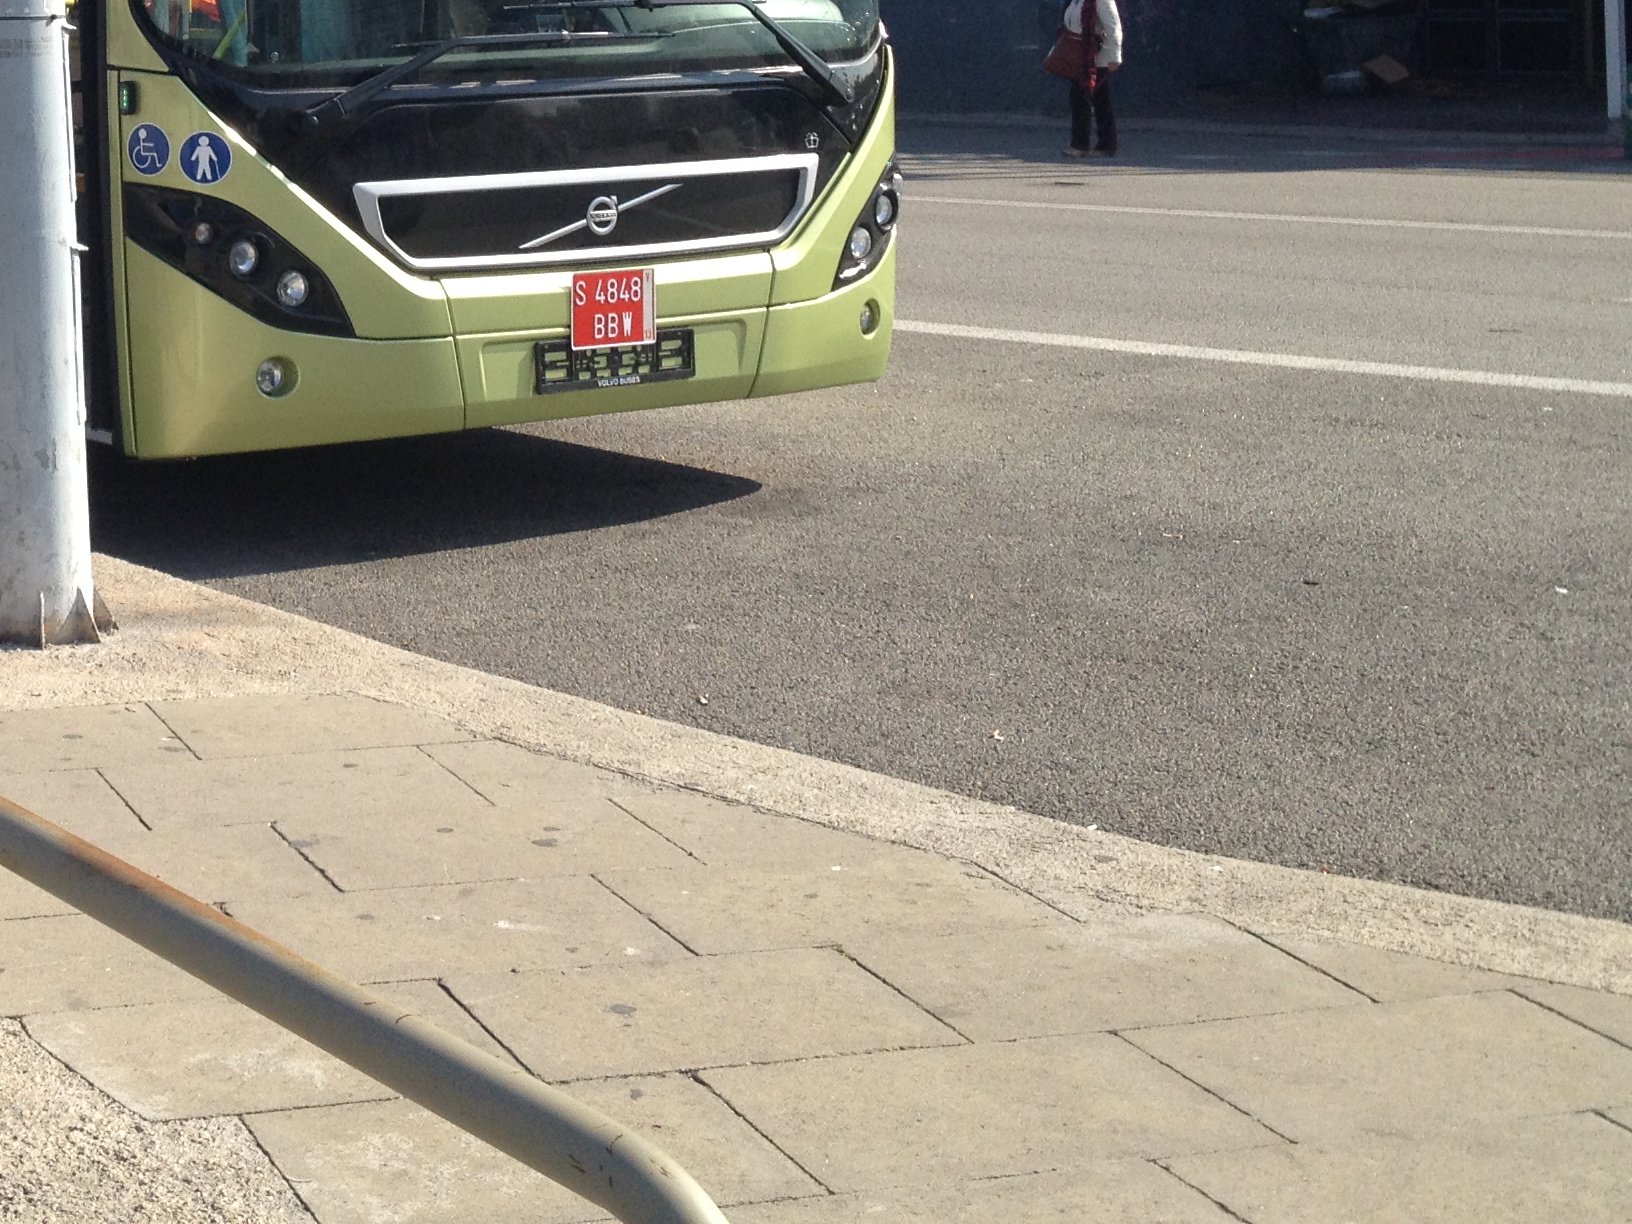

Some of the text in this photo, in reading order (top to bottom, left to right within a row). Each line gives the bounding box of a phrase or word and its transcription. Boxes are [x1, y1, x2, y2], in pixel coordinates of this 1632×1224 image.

[575, 276, 641, 306] S 4848
[594, 311, 633, 339] BBW
[597, 375, 641, 387] VOLVO BUSES
